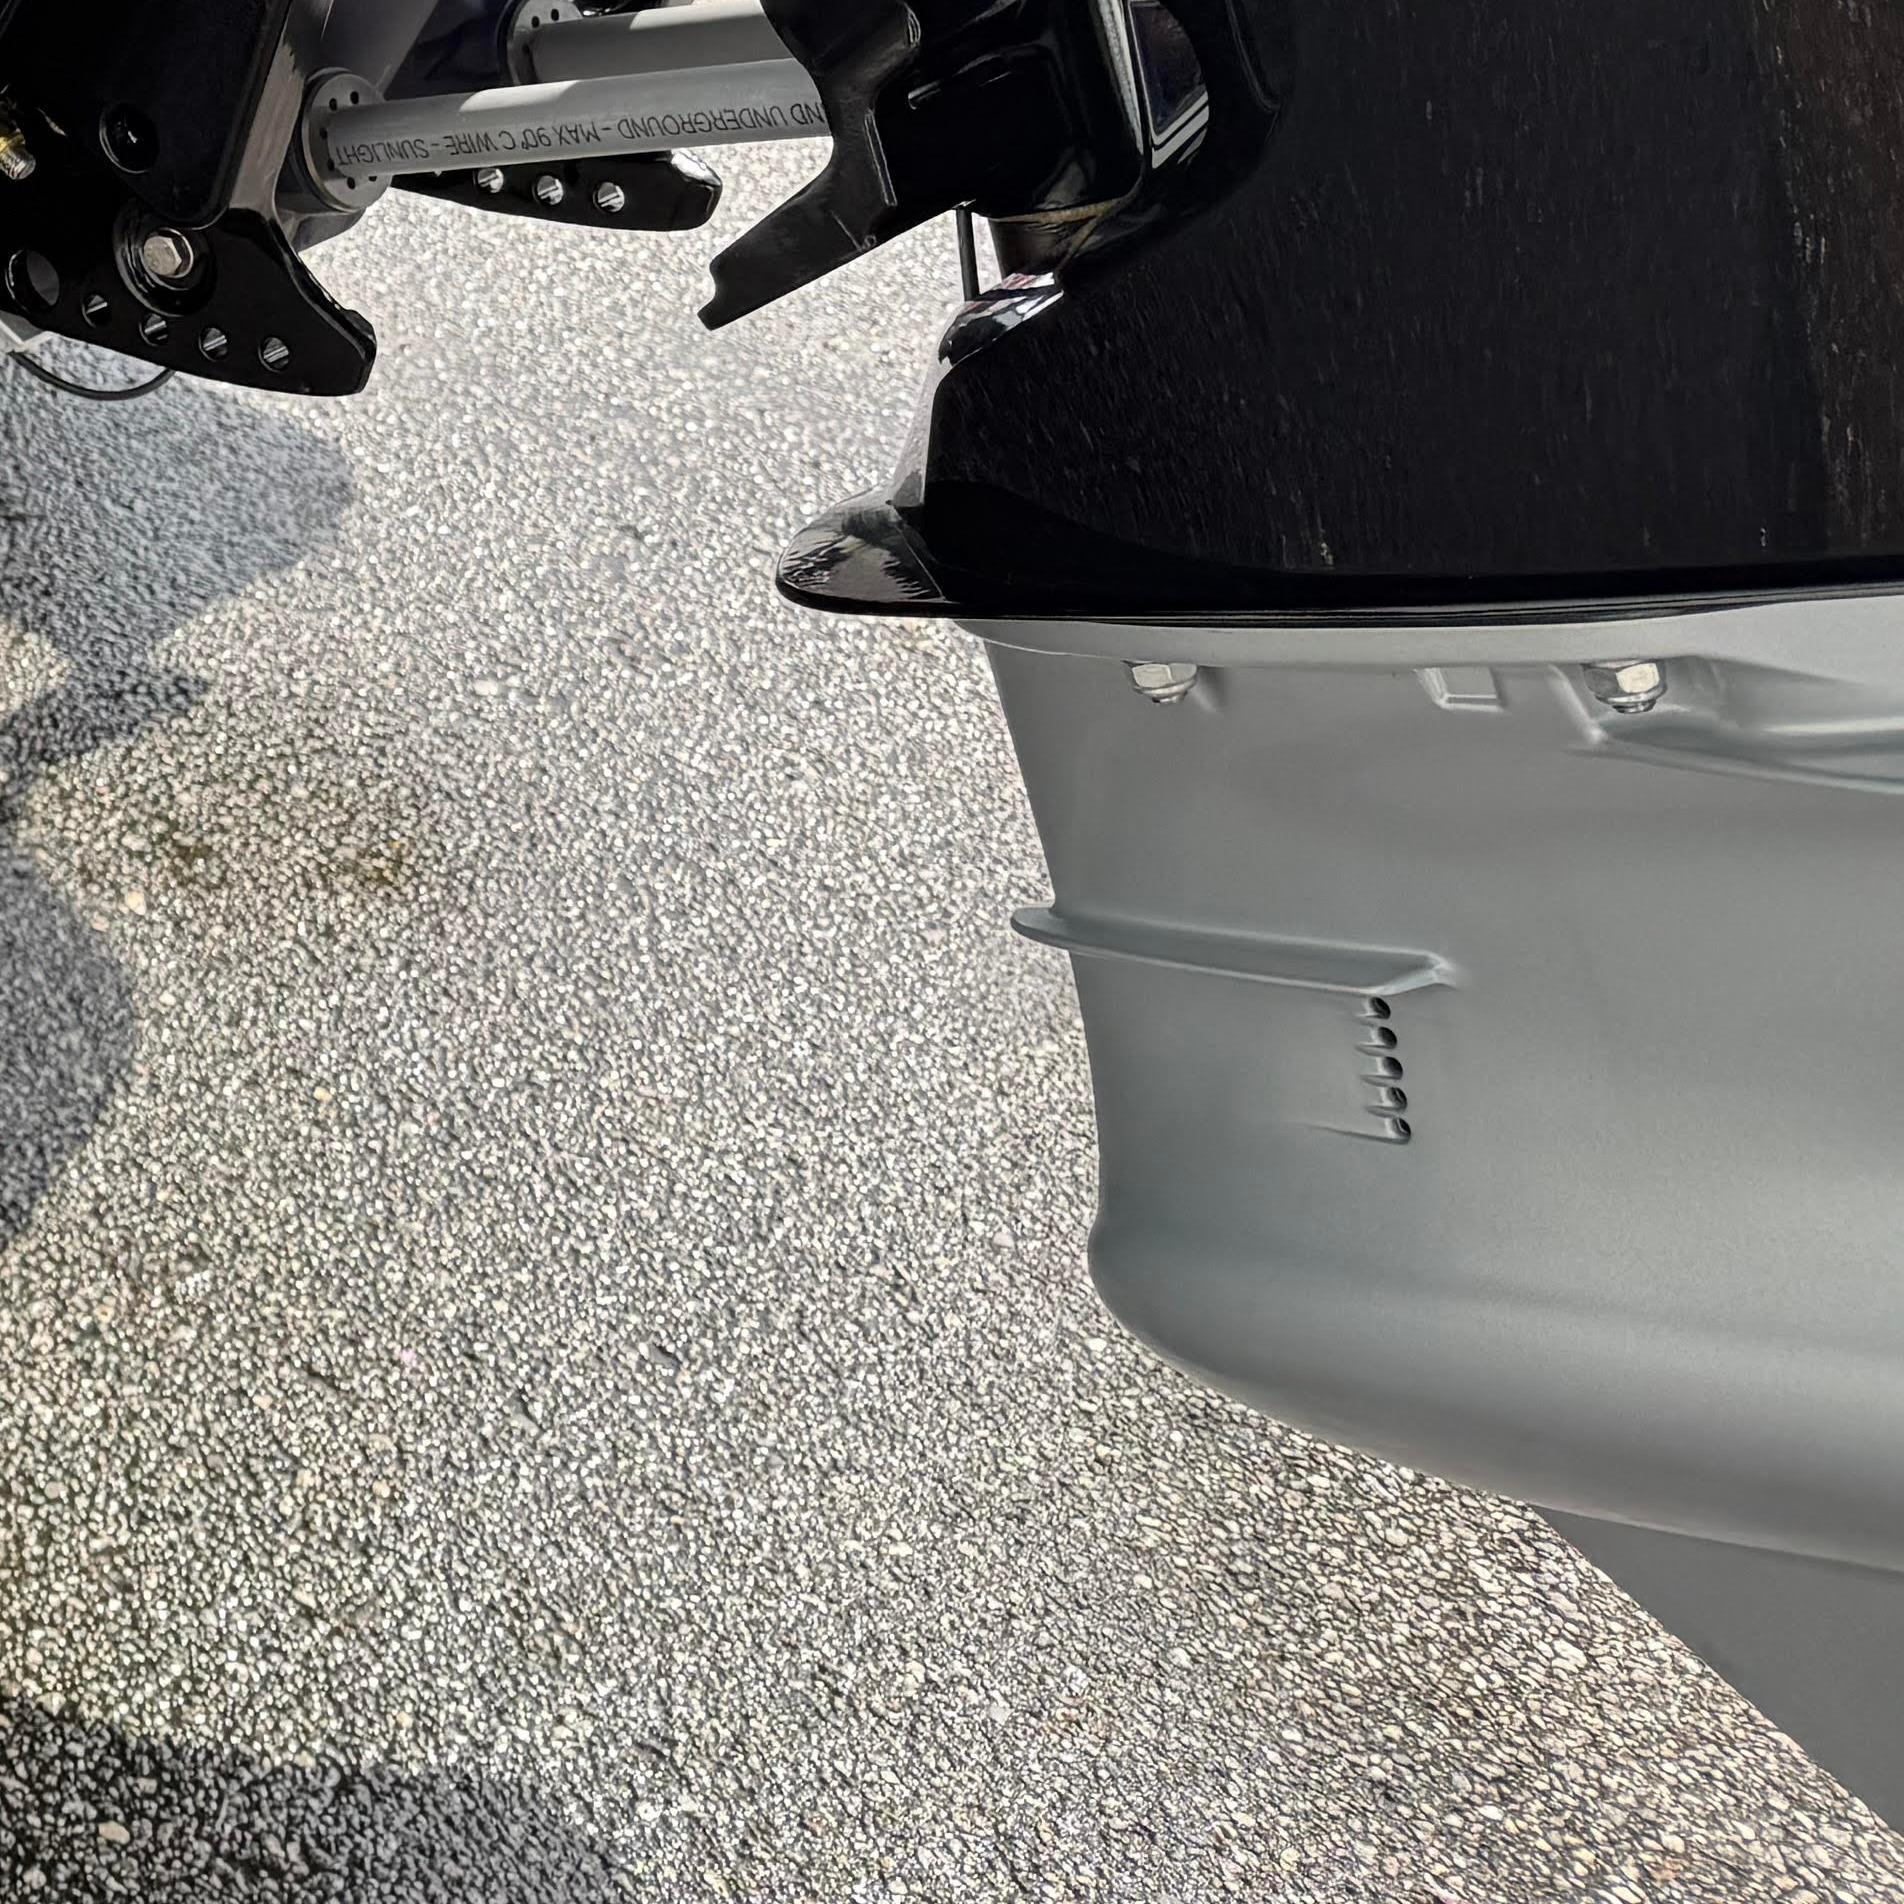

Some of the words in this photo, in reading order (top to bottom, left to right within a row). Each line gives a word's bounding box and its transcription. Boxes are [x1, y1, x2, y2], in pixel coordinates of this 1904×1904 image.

[617, 105, 789, 140] UNDERGROUND
[791, 102, 829, 125] ND
[443, 132, 495, 156] WIRE
[552, 120, 602, 146] MAX
[335, 138, 430, 165] SUNLIGHT
